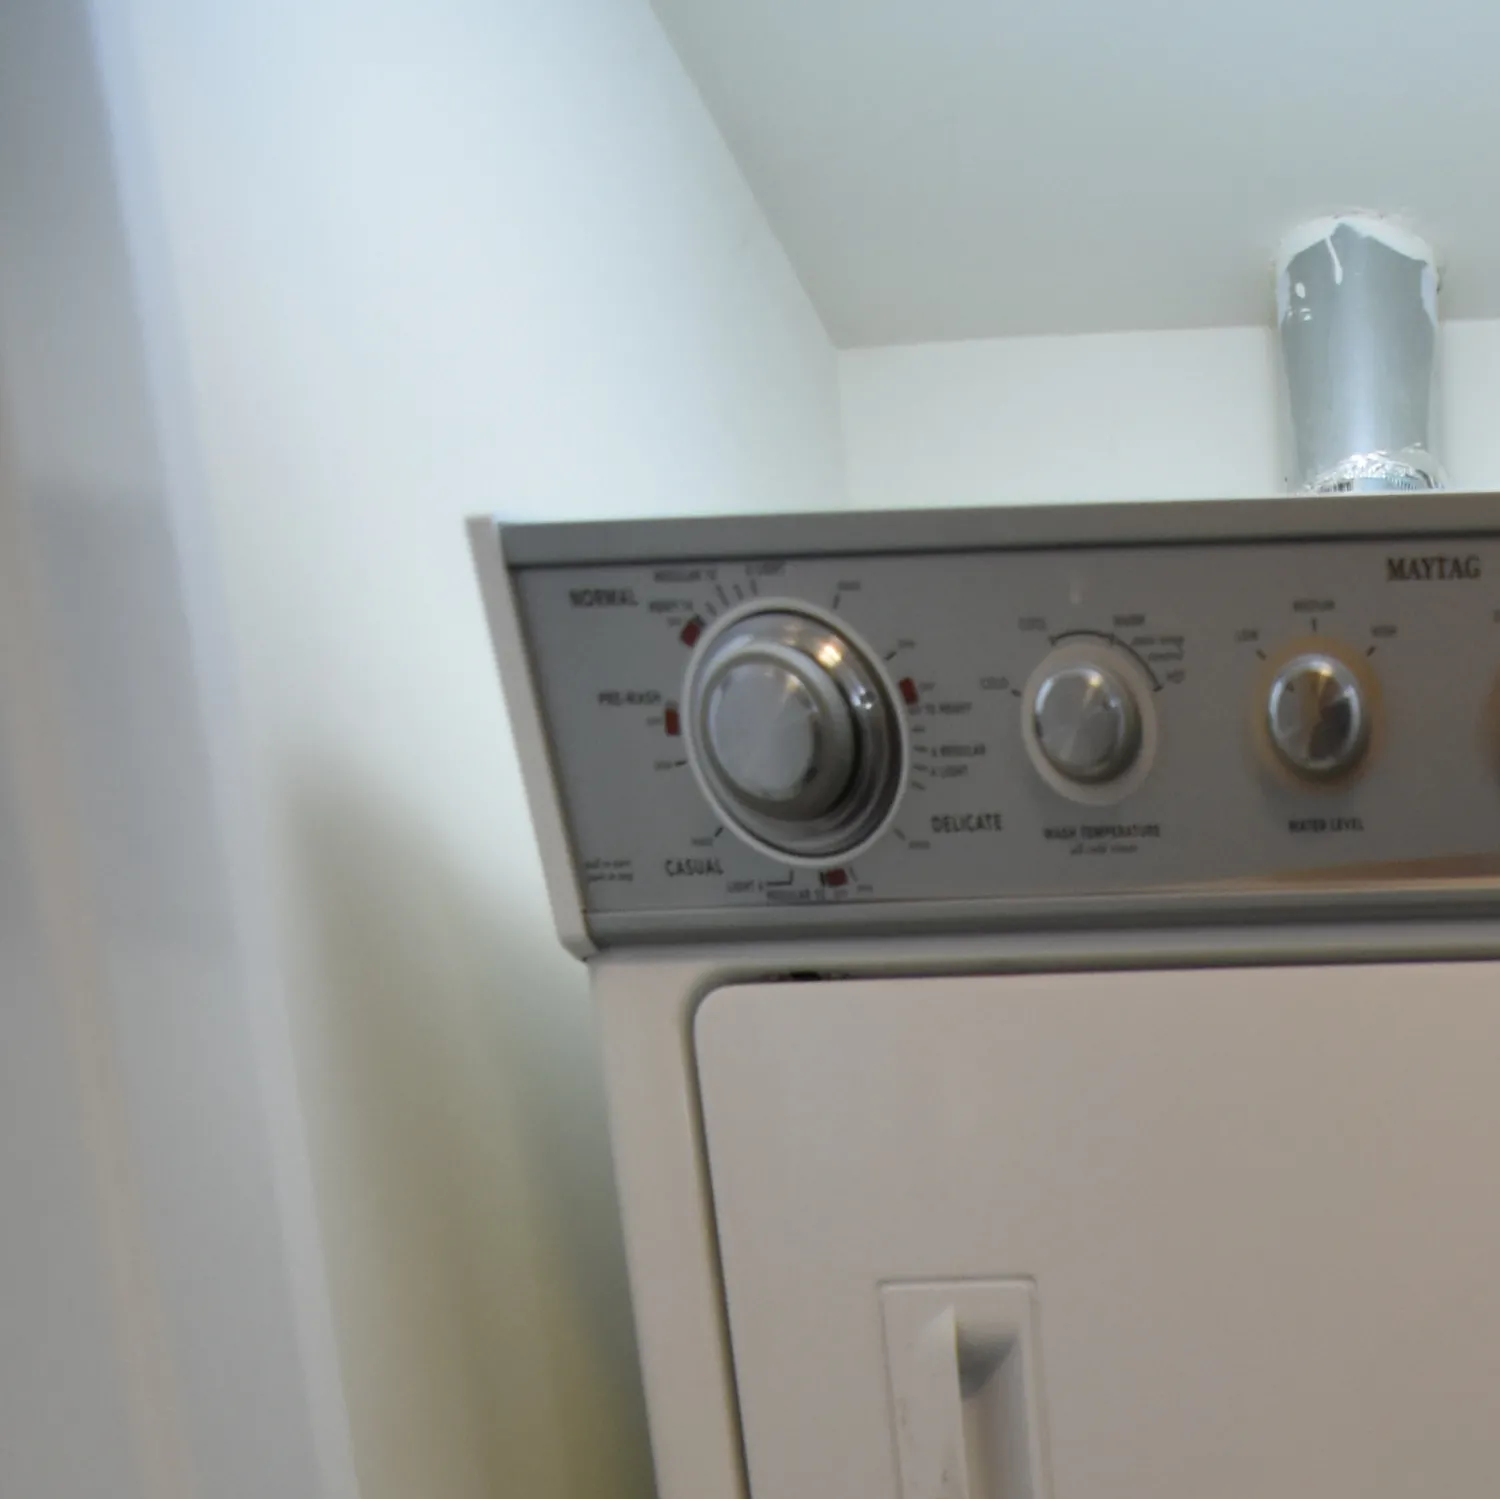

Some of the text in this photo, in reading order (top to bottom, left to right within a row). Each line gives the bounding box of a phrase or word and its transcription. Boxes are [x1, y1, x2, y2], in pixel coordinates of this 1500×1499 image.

[1386, 554, 1482, 582] MAYTAG
[568, 588, 639, 608] NORMAL
[930, 813, 1004, 834] DELICATE
[1080, 823, 1161, 840] TEMPERATURE
[1330, 816, 1365, 833] LEVEL
[664, 857, 726, 877] CASUAL
